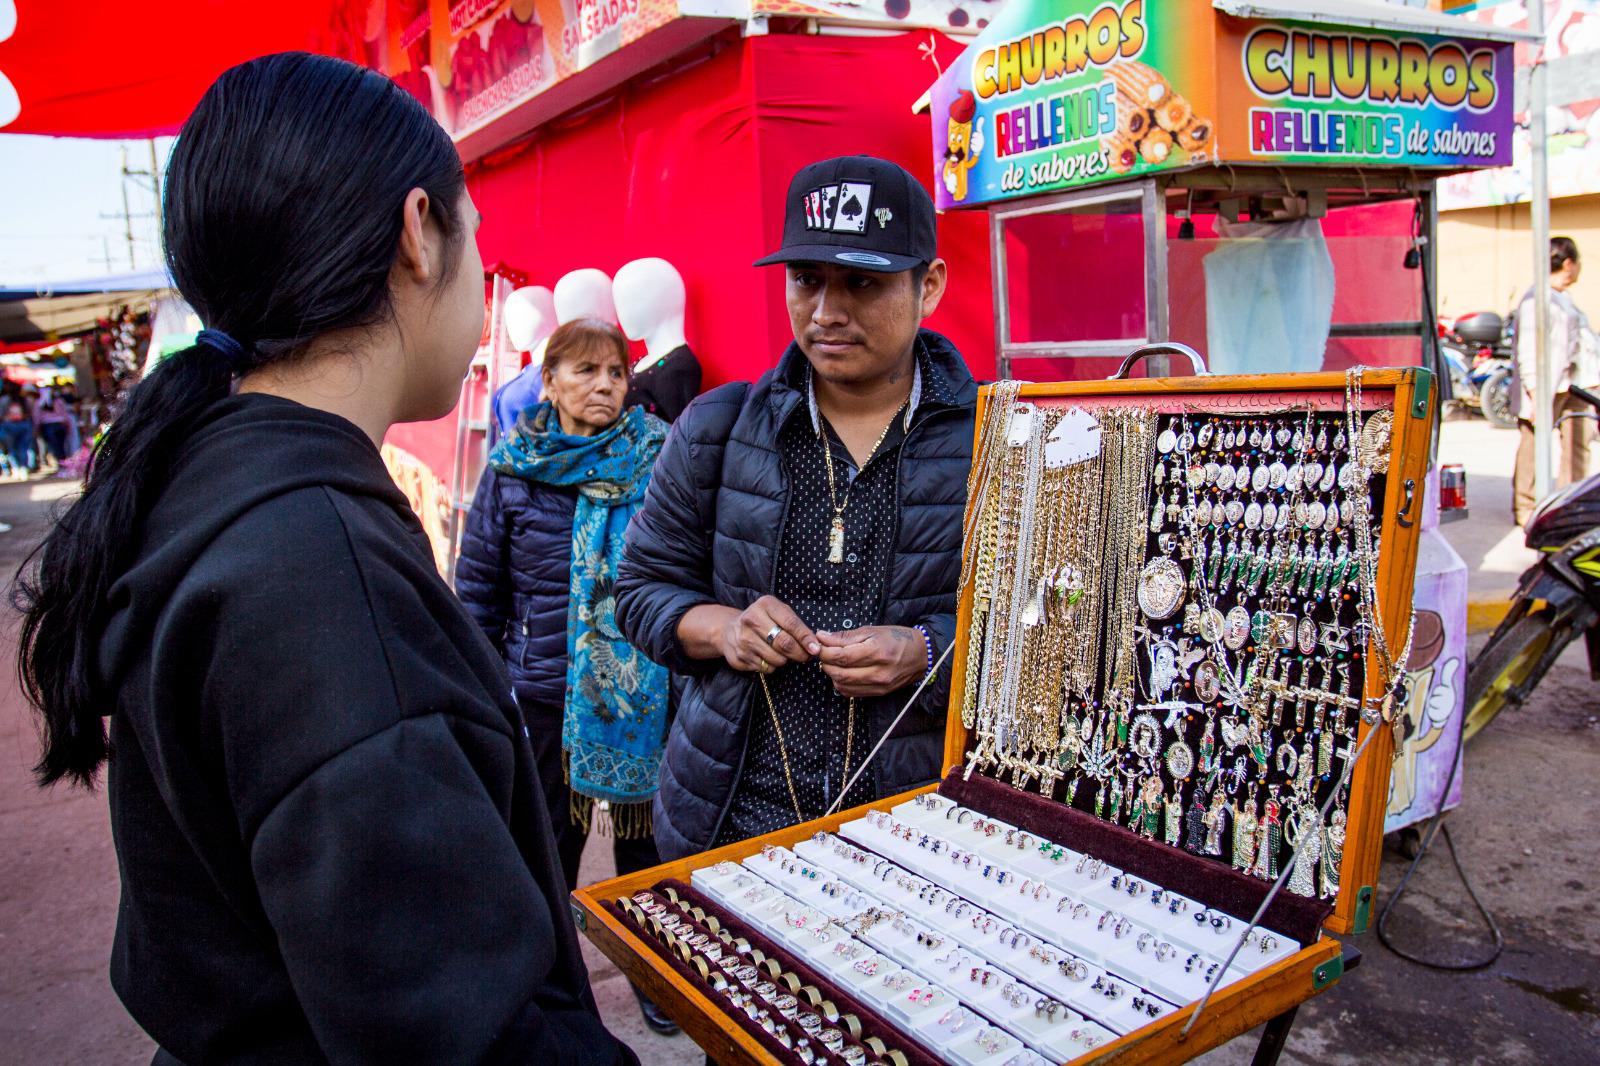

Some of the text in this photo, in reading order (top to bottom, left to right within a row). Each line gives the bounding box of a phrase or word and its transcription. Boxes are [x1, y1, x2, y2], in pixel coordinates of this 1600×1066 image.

[973, 0, 1145, 99] CHURROS
[1246, 28, 1497, 109] CHURROS
[996, 83, 1117, 158] RELLENOS
[1251, 111, 1496, 157] RELLENOS de sabores
[1000, 148, 1110, 193] de sabores
